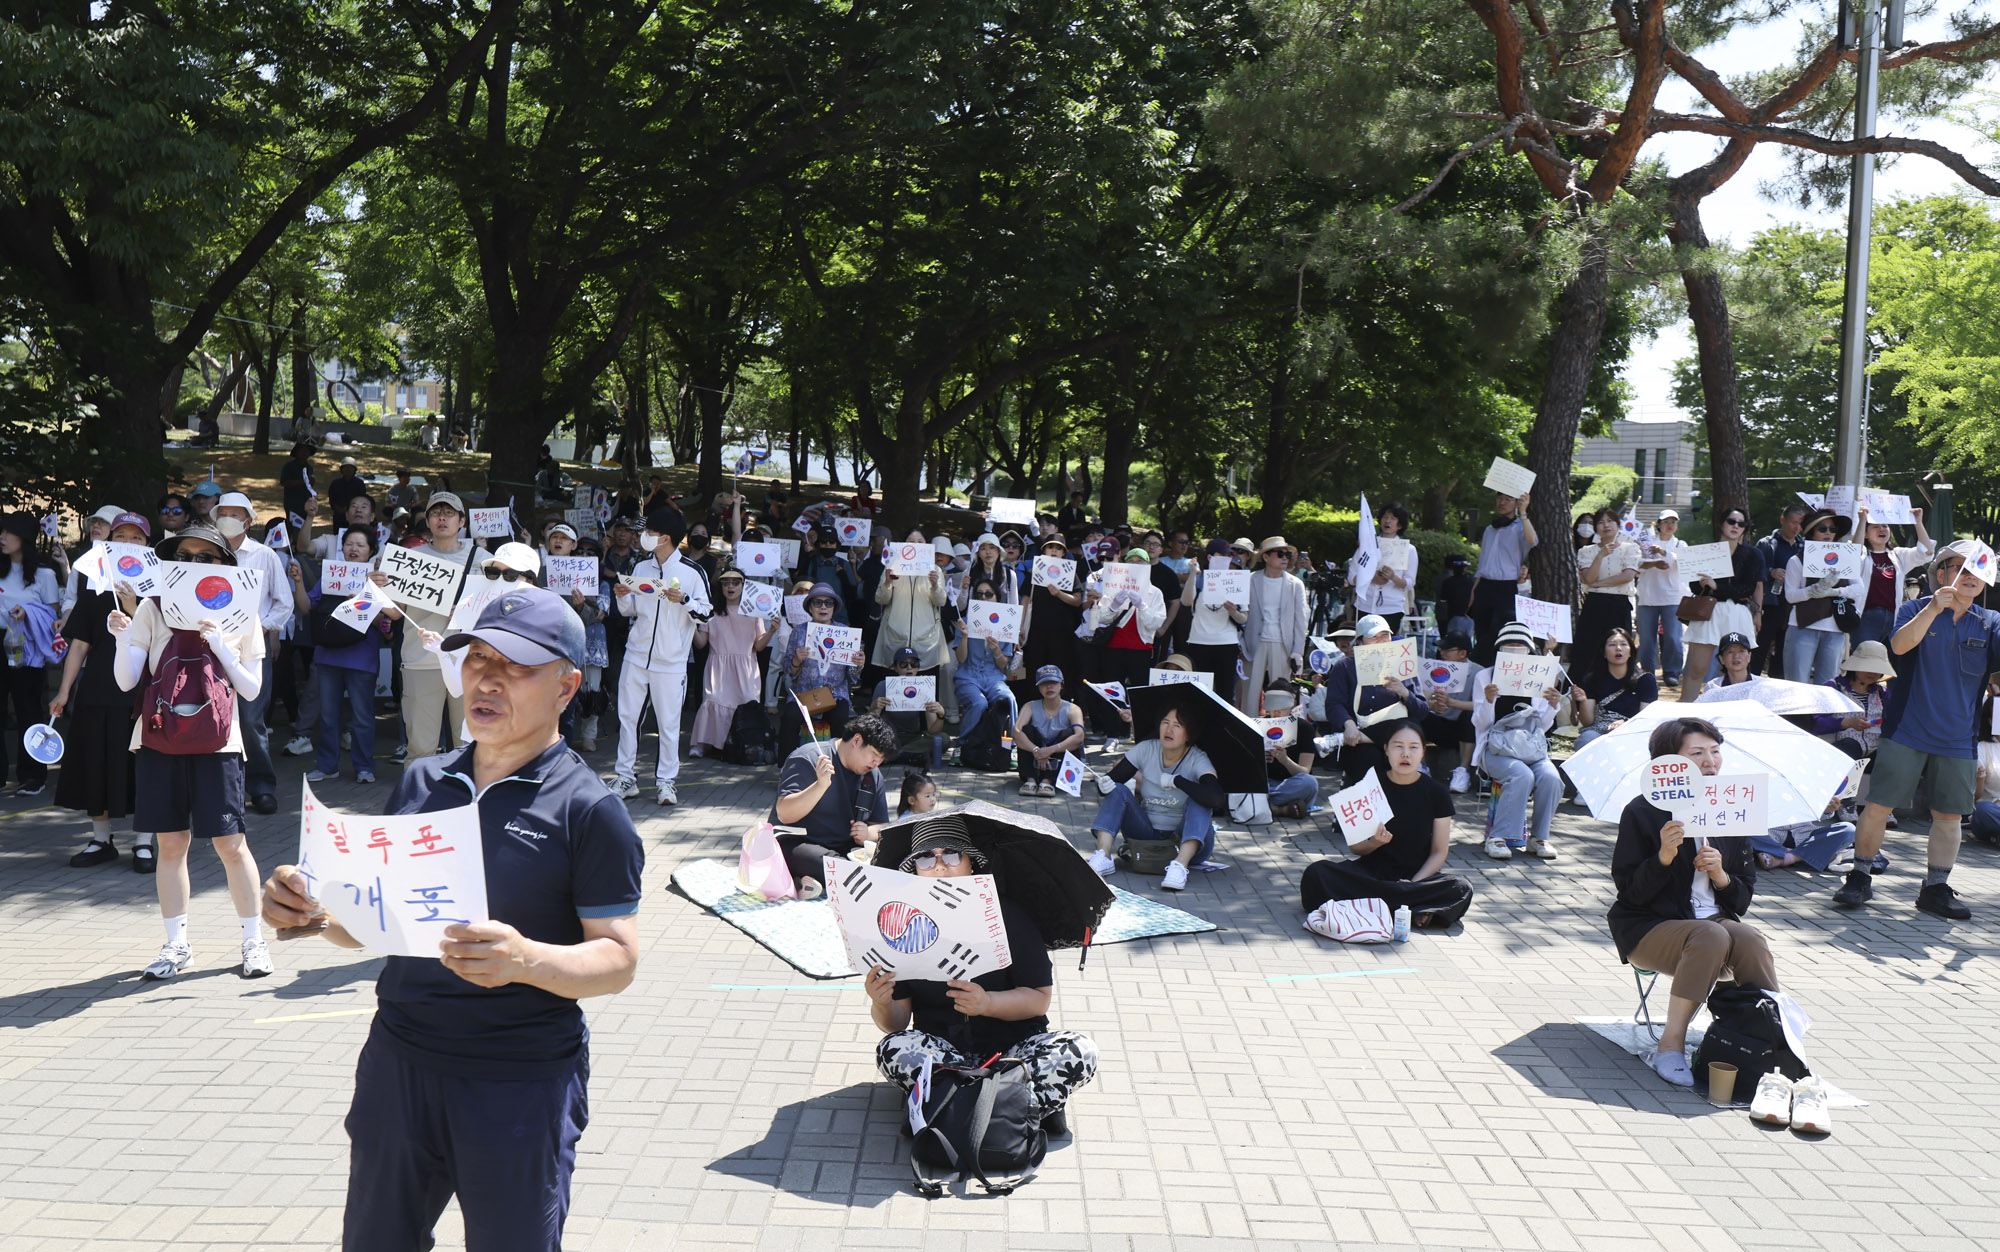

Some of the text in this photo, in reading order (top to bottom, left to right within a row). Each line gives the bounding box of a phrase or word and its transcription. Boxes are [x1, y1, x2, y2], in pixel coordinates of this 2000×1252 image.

[474, 512, 500, 523] 부정선거
[477, 523, 503, 532] 재선거
[327, 564, 347, 577] 부정
[387, 550, 455, 584] 부정선거
[1206, 571, 1221, 579] STOP
[329, 581, 341, 591] 재
[1221, 578, 1234, 586] THE
[383, 575, 445, 606] 재선거
[1225, 586, 1243, 594] STEAL
[1517, 597, 1558, 621] 부정선거
[817, 626, 849, 638] 부정선거
[1729, 633, 1739, 642] NY
[901, 677, 924, 686] Freedom
[1160, 673, 1200, 684] 부정선거
[1651, 763, 1688, 775] STOP
[1658, 776, 1685, 787] THE
[1651, 789, 1694, 801] STEAL
[1692, 784, 1754, 806] 정선거
[1691, 809, 1746, 826] 재선거
